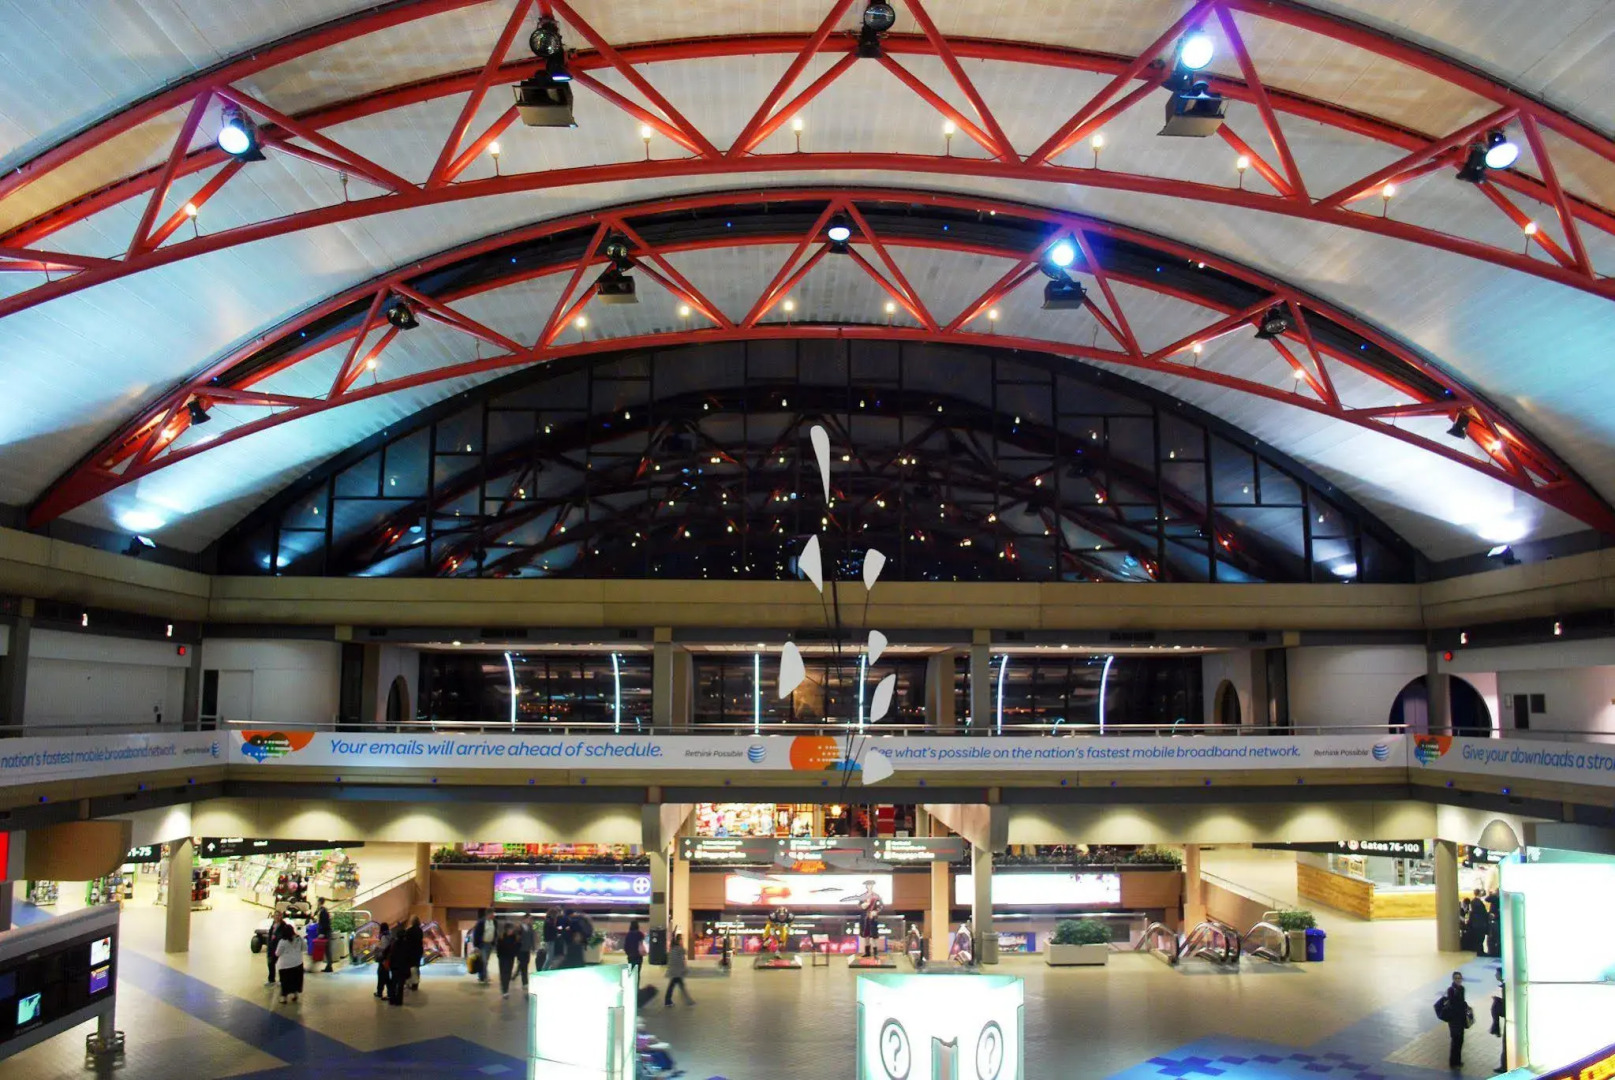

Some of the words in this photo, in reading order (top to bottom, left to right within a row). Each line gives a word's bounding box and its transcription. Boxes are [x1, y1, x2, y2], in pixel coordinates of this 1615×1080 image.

[331, 739, 367, 754] Your
[369, 739, 424, 755] emails
[427, 740, 455, 756] will
[456, 741, 504, 756] arrive
[507, 742, 563, 757] ahead
[564, 742, 582, 757] of
[584, 742, 664, 757] schedule.
[685, 749, 712, 758] Rethink
[713, 749, 743, 758] Possible
[895, 746, 937, 759] what's
[938, 746, 991, 761] possible
[993, 749, 1006, 759] on
[1012, 746, 1032, 759] the
[1034, 746, 1084, 759] nation's
[1086, 746, 1130, 759] fastest
[1132, 745, 1175, 759] mobile
[1176, 745, 1247, 758] broadband
[1249, 744, 1301, 757] network.
[1314, 749, 1339, 757] Rethink
[1, 751, 41, 768] nation's
[42, 749, 74, 767] fastest
[1463, 743, 1485, 760] Give
[1485, 748, 1510, 765] your
[1510, 746, 1574, 768] downloads
[1576, 754, 1585, 768] a
[1586, 753, 1615, 771] stro
[1361, 839, 1388, 851] Gates
[1389, 842, 1420, 853] 76-100
